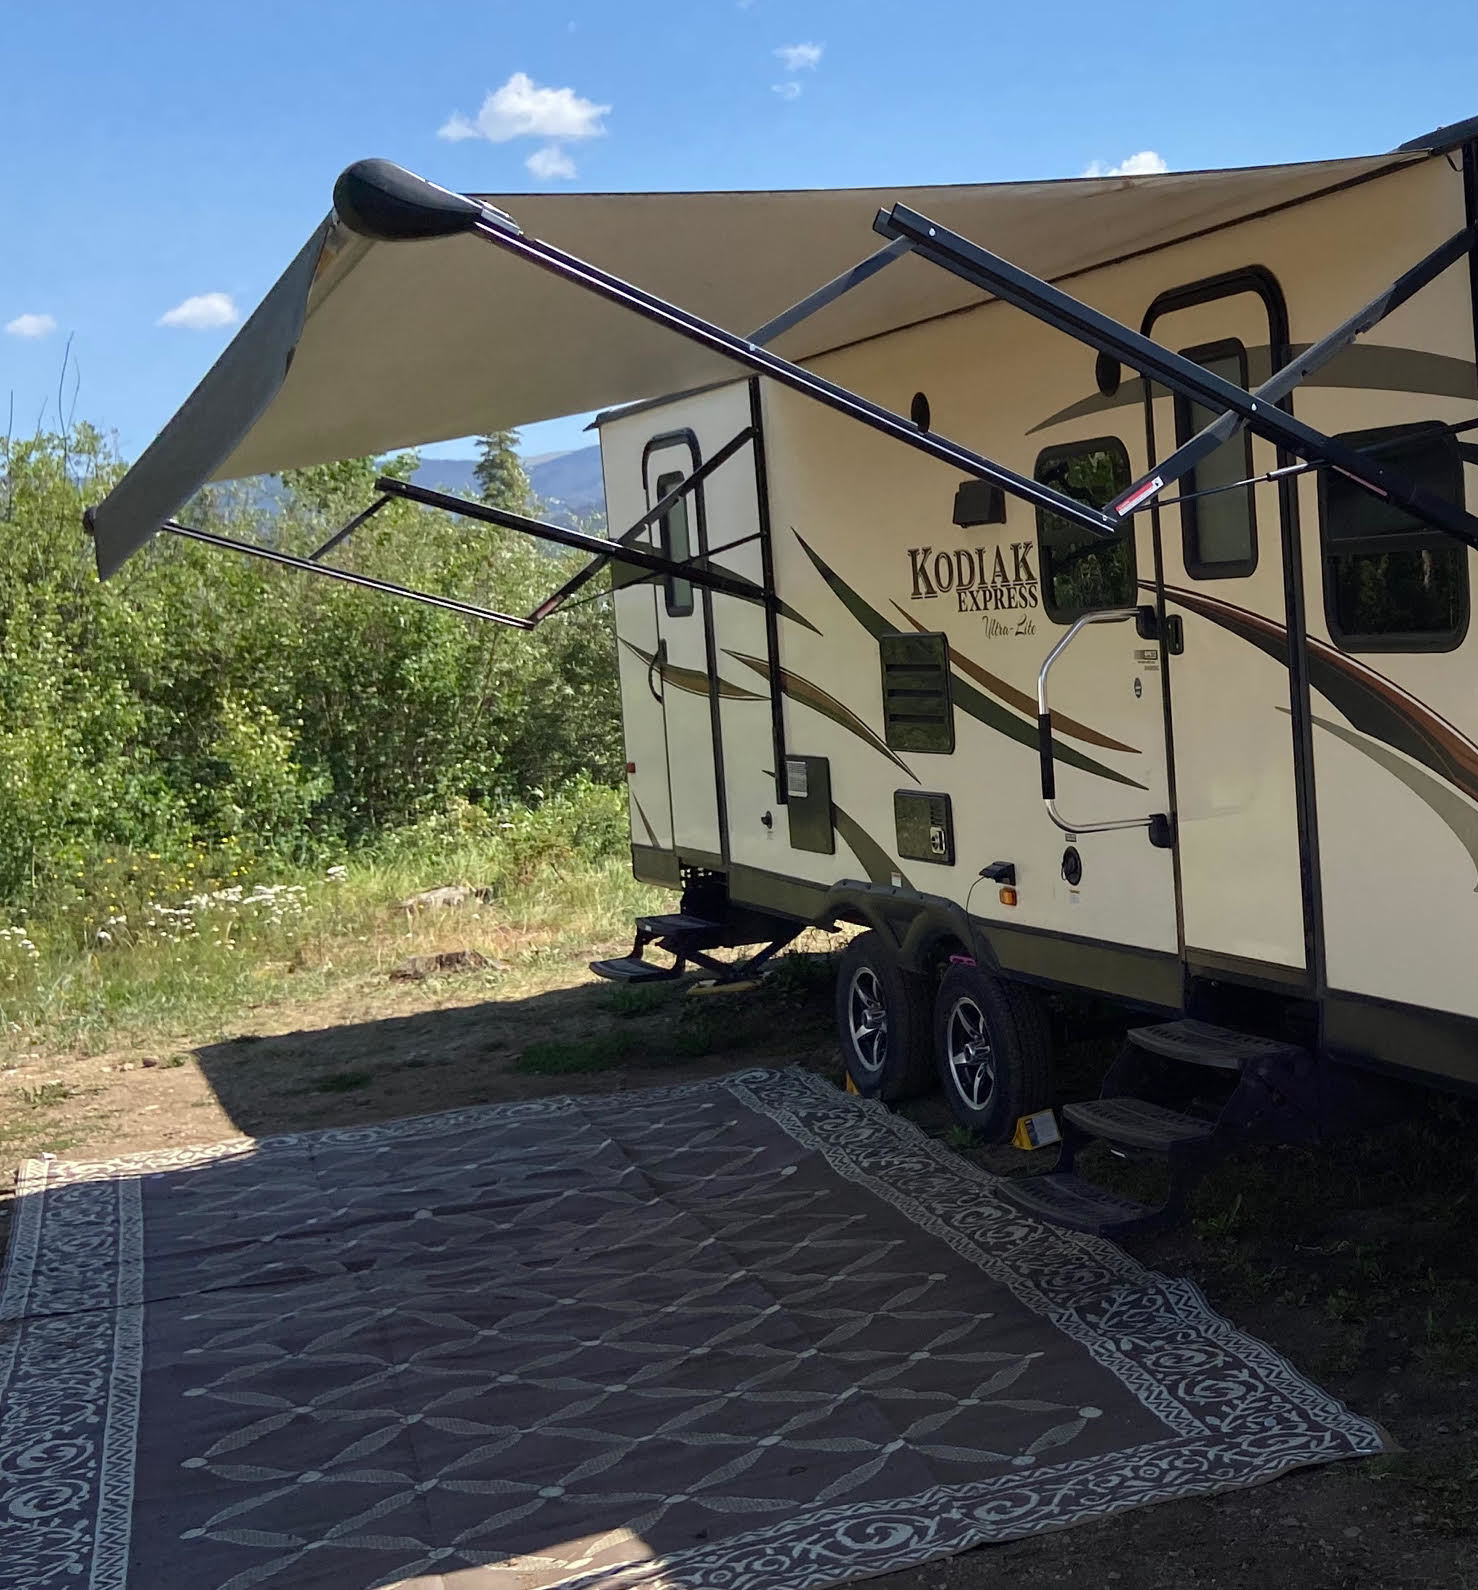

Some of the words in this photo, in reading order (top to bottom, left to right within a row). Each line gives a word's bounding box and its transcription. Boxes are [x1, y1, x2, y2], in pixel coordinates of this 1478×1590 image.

[907, 541, 1038, 600] KODIAK
[956, 585, 1039, 612] EXPRESS
[981, 613, 1037, 639] Ultra-Lite
